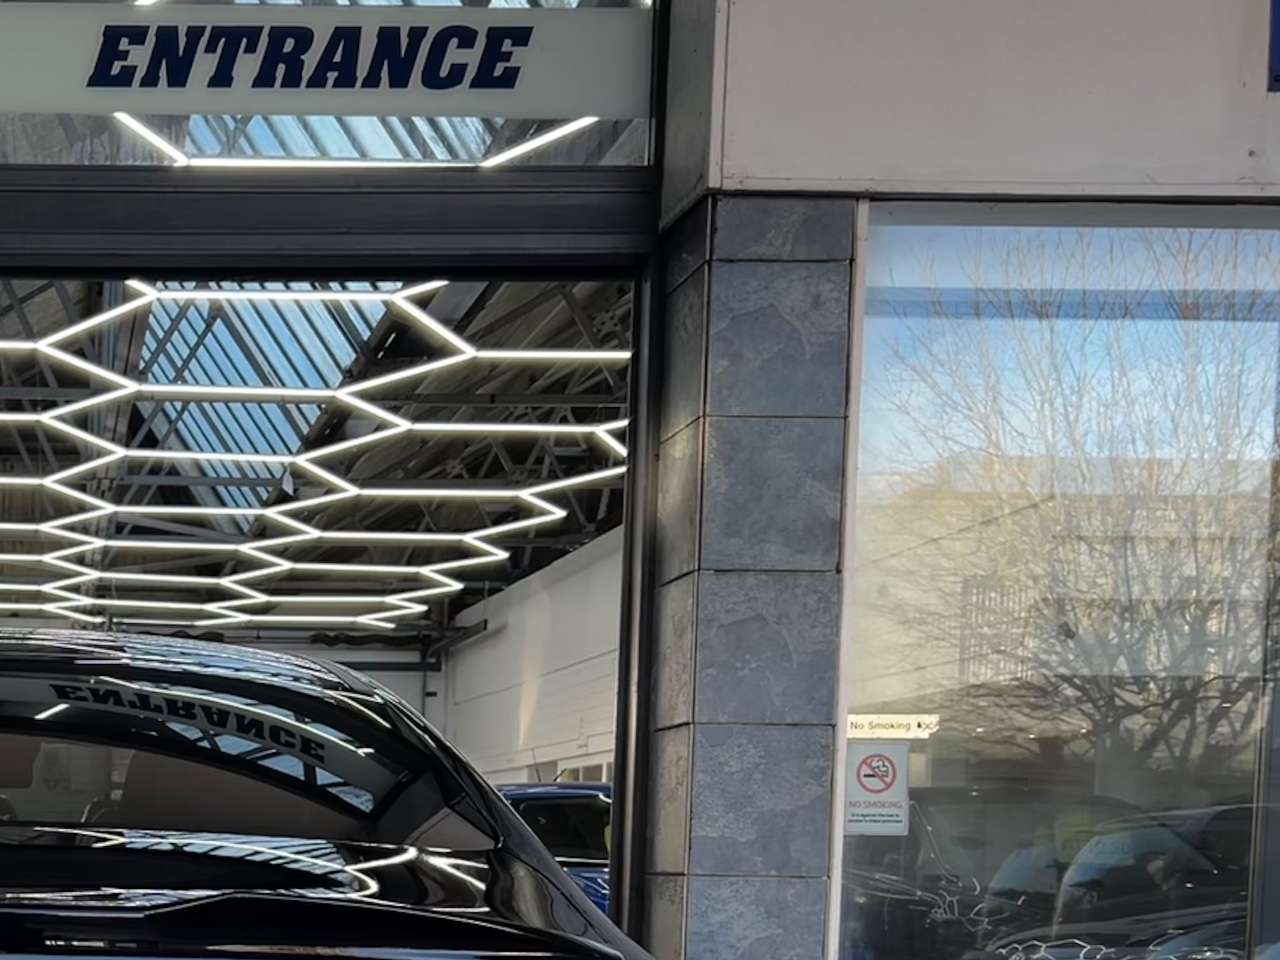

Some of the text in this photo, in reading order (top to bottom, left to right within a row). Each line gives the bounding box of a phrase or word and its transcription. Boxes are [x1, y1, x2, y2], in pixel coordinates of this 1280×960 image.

[86, 25, 534, 91] ENTRANCE
[849, 721, 864, 730] No
[868, 721, 911, 732] Smoking
[848, 800, 903, 809] NO SMOKING
